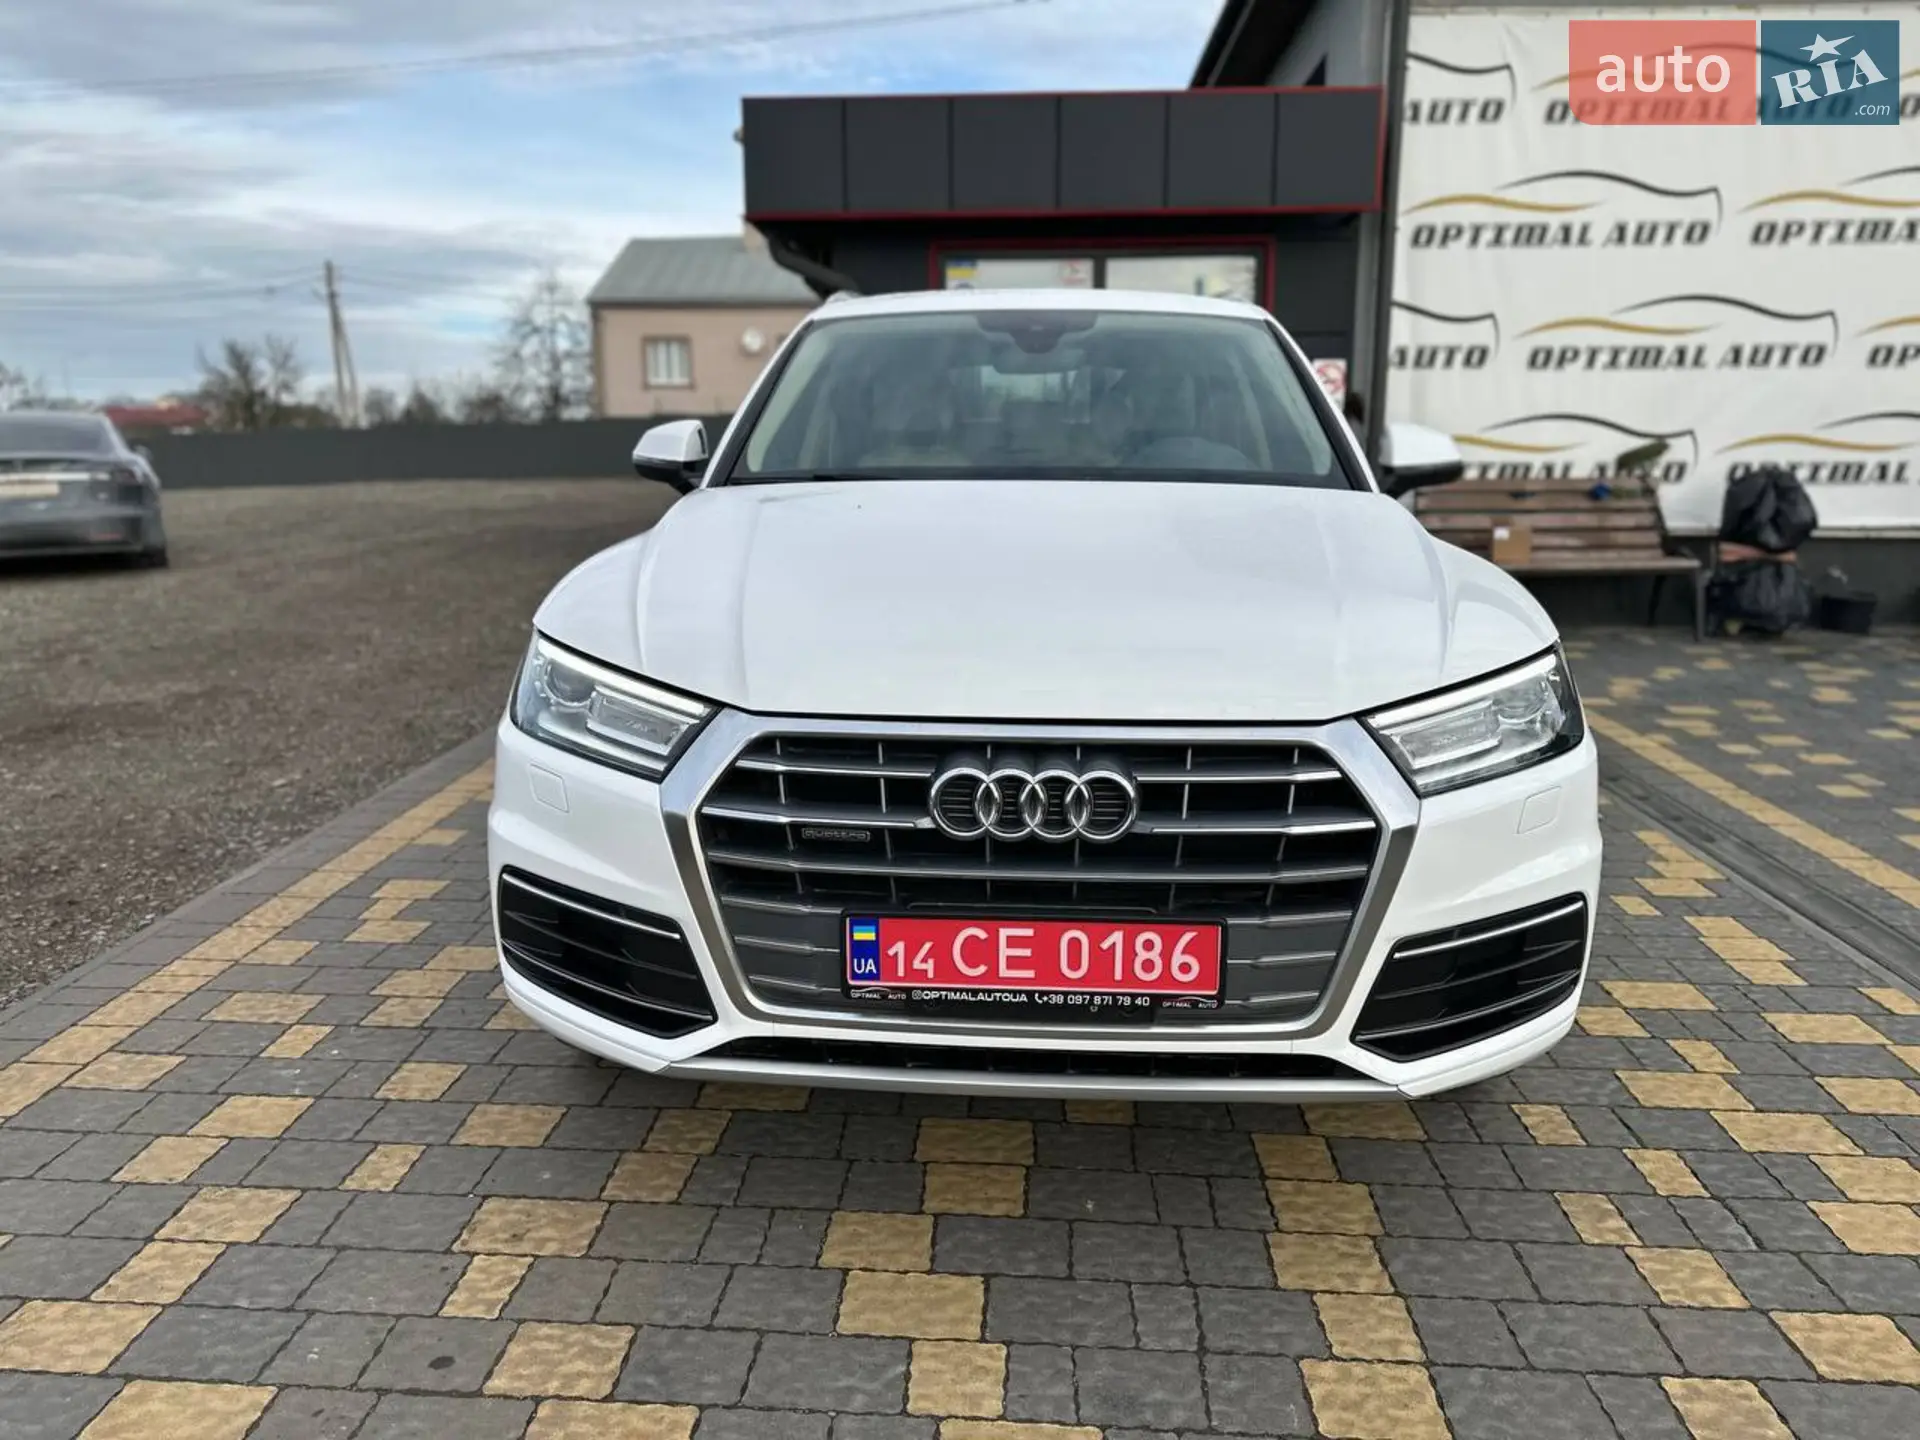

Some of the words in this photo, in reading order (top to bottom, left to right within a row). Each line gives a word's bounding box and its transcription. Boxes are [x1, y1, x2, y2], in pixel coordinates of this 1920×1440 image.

[1410, 221, 1592, 249] OPTIMAL
[1601, 220, 1713, 247] AUTO
[1526, 344, 1707, 372] OPTIMAL
[1717, 342, 1827, 369] AUTO
[853, 960, 877, 974] UA
[887, 940, 936, 979] 14
[951, 926, 1036, 979] CE
[1059, 929, 1200, 982] 0186
[1067, 994, 1090, 1005] 097
[1093, 995, 1113, 1006] 871
[1117, 996, 1131, 1006] 79
[1135, 996, 1150, 1007] 40
